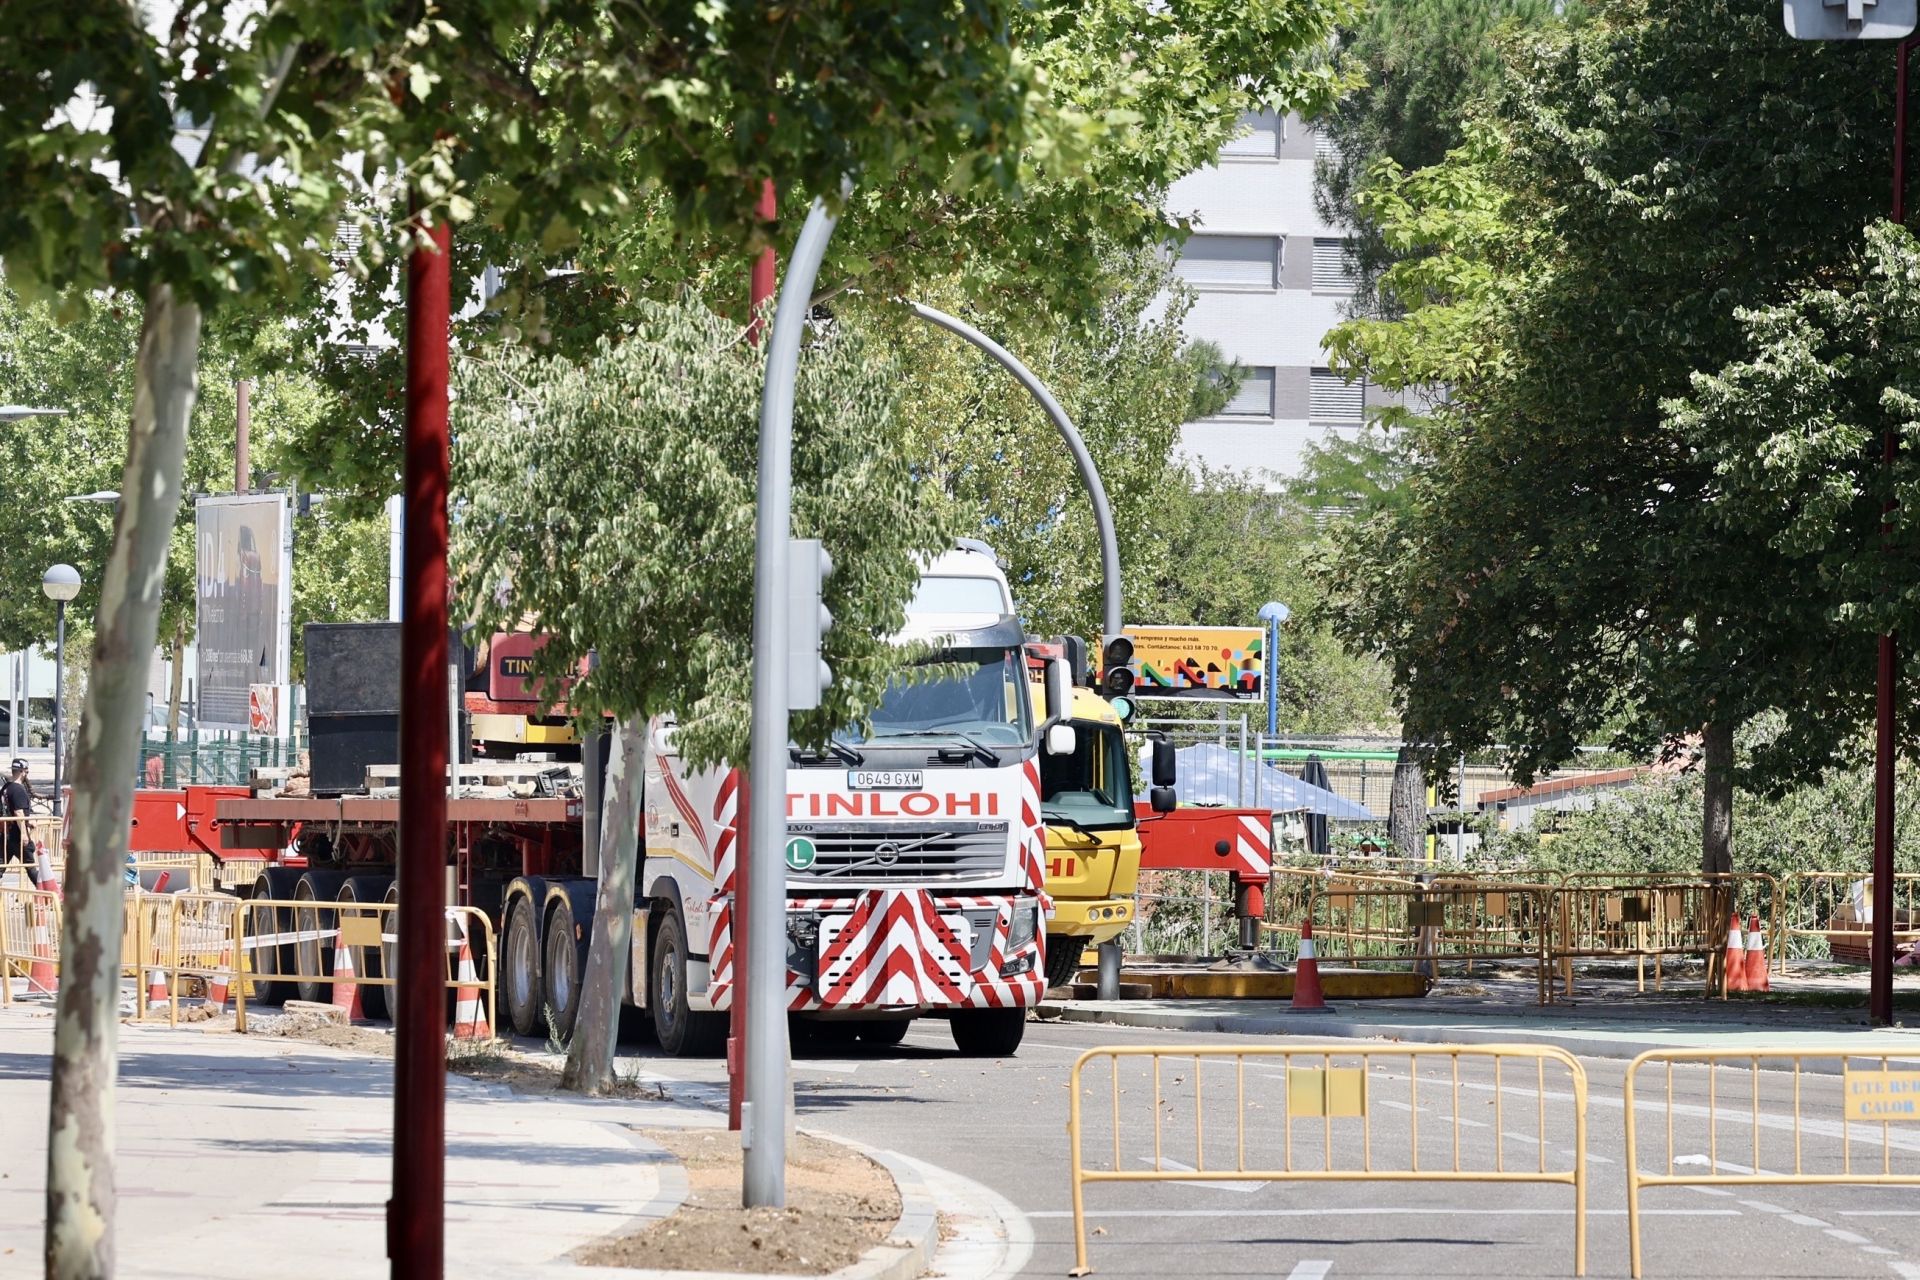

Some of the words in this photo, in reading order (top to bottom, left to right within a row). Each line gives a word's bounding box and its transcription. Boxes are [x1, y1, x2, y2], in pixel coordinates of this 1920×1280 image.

[201, 530, 224, 599] ID.4
[857, 773, 890, 785] 0649
[894, 773, 920, 785] GXM
[793, 843, 807, 864] L
